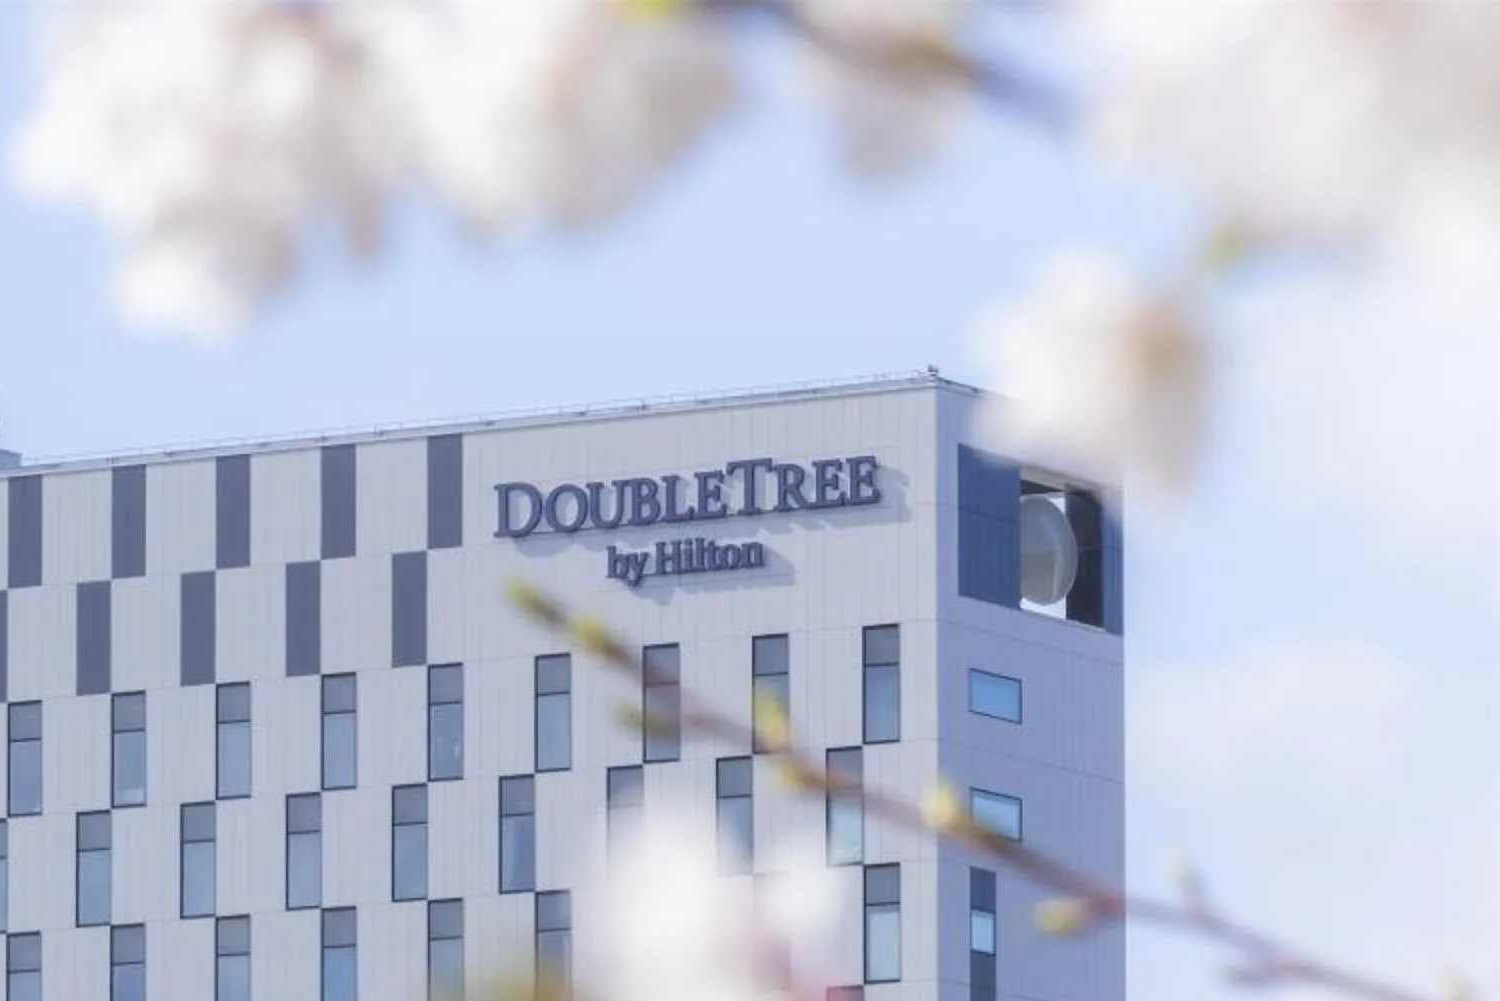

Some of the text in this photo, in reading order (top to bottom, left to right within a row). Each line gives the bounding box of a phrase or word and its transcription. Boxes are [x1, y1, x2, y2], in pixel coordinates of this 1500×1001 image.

[493, 456, 881, 538] DOUBLETREE
[607, 538, 765, 586] by Hilton
